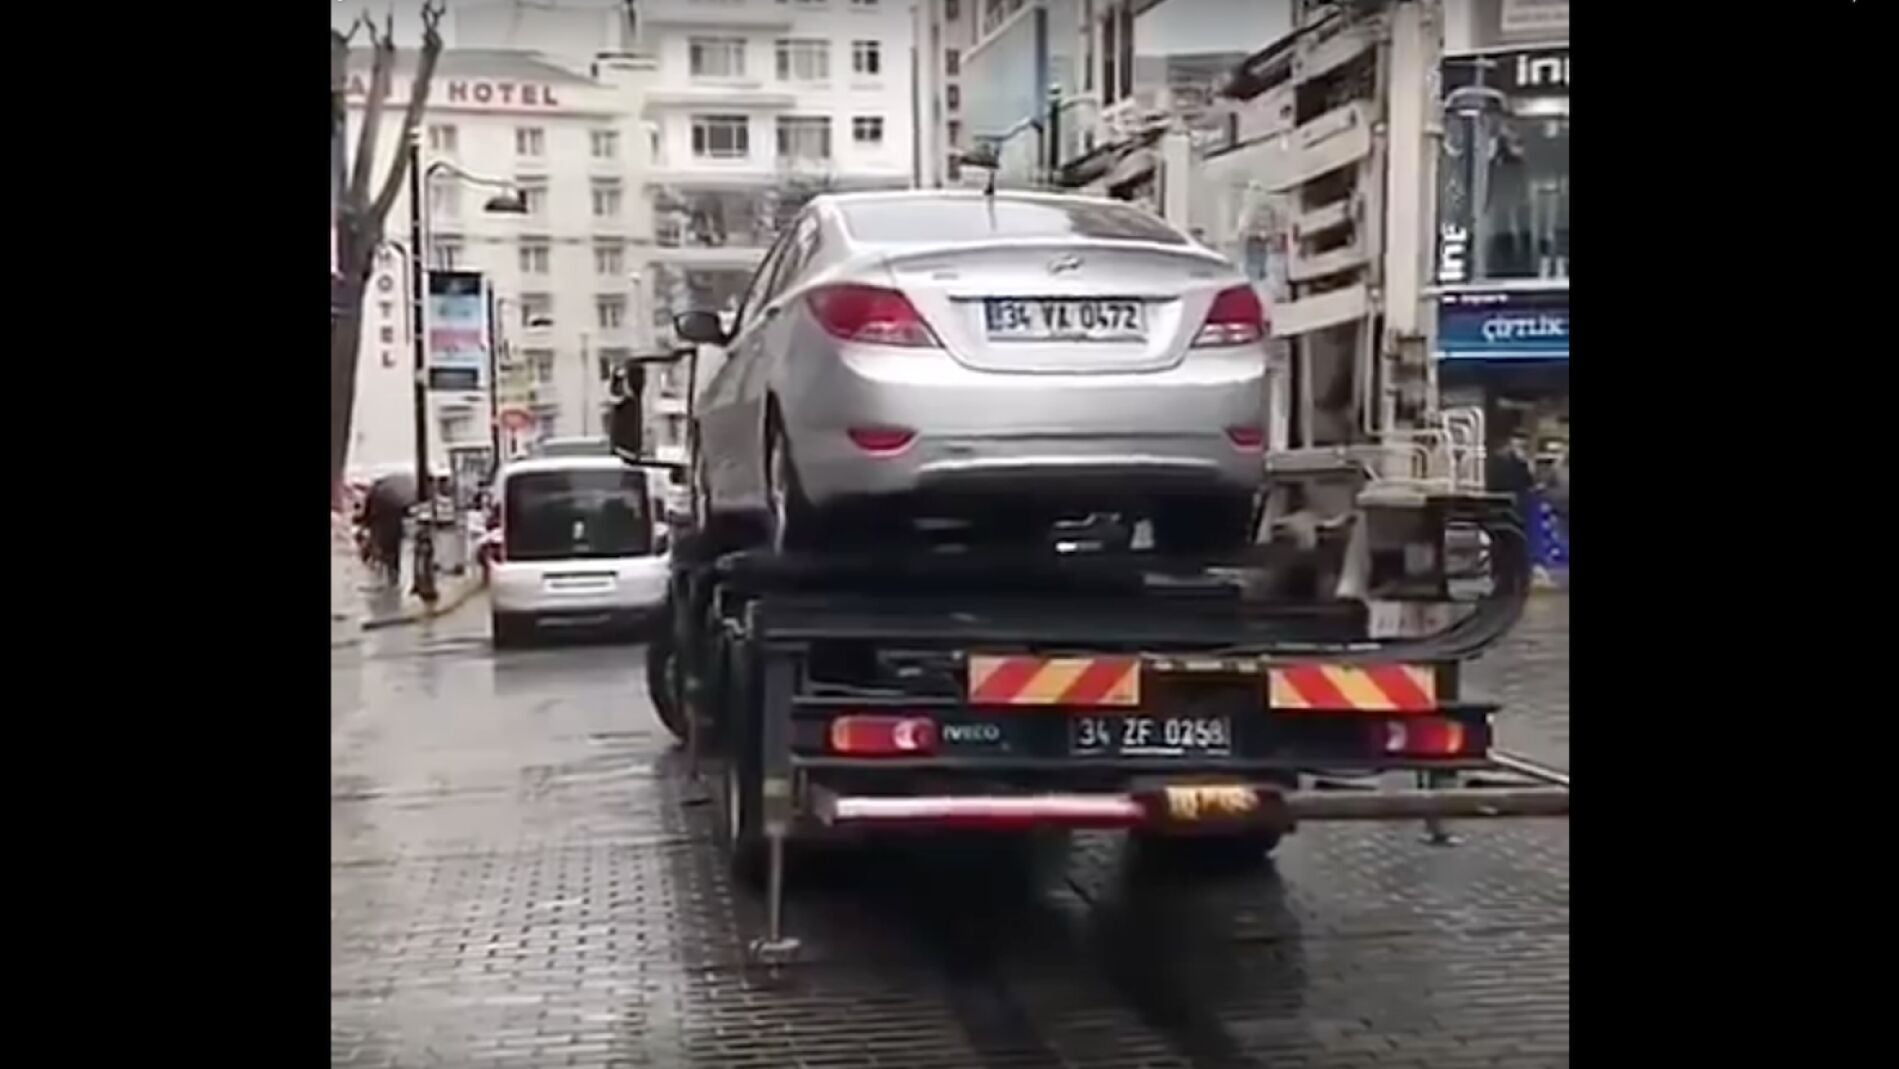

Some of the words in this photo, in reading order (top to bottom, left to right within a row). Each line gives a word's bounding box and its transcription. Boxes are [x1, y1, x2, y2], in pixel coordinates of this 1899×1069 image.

[1517, 54, 1568, 86] in
[449, 81, 558, 106] HOTEL
[943, 725, 999, 740] IVECO
[1078, 718, 1109, 746] 34
[1123, 718, 1151, 746] ZF
